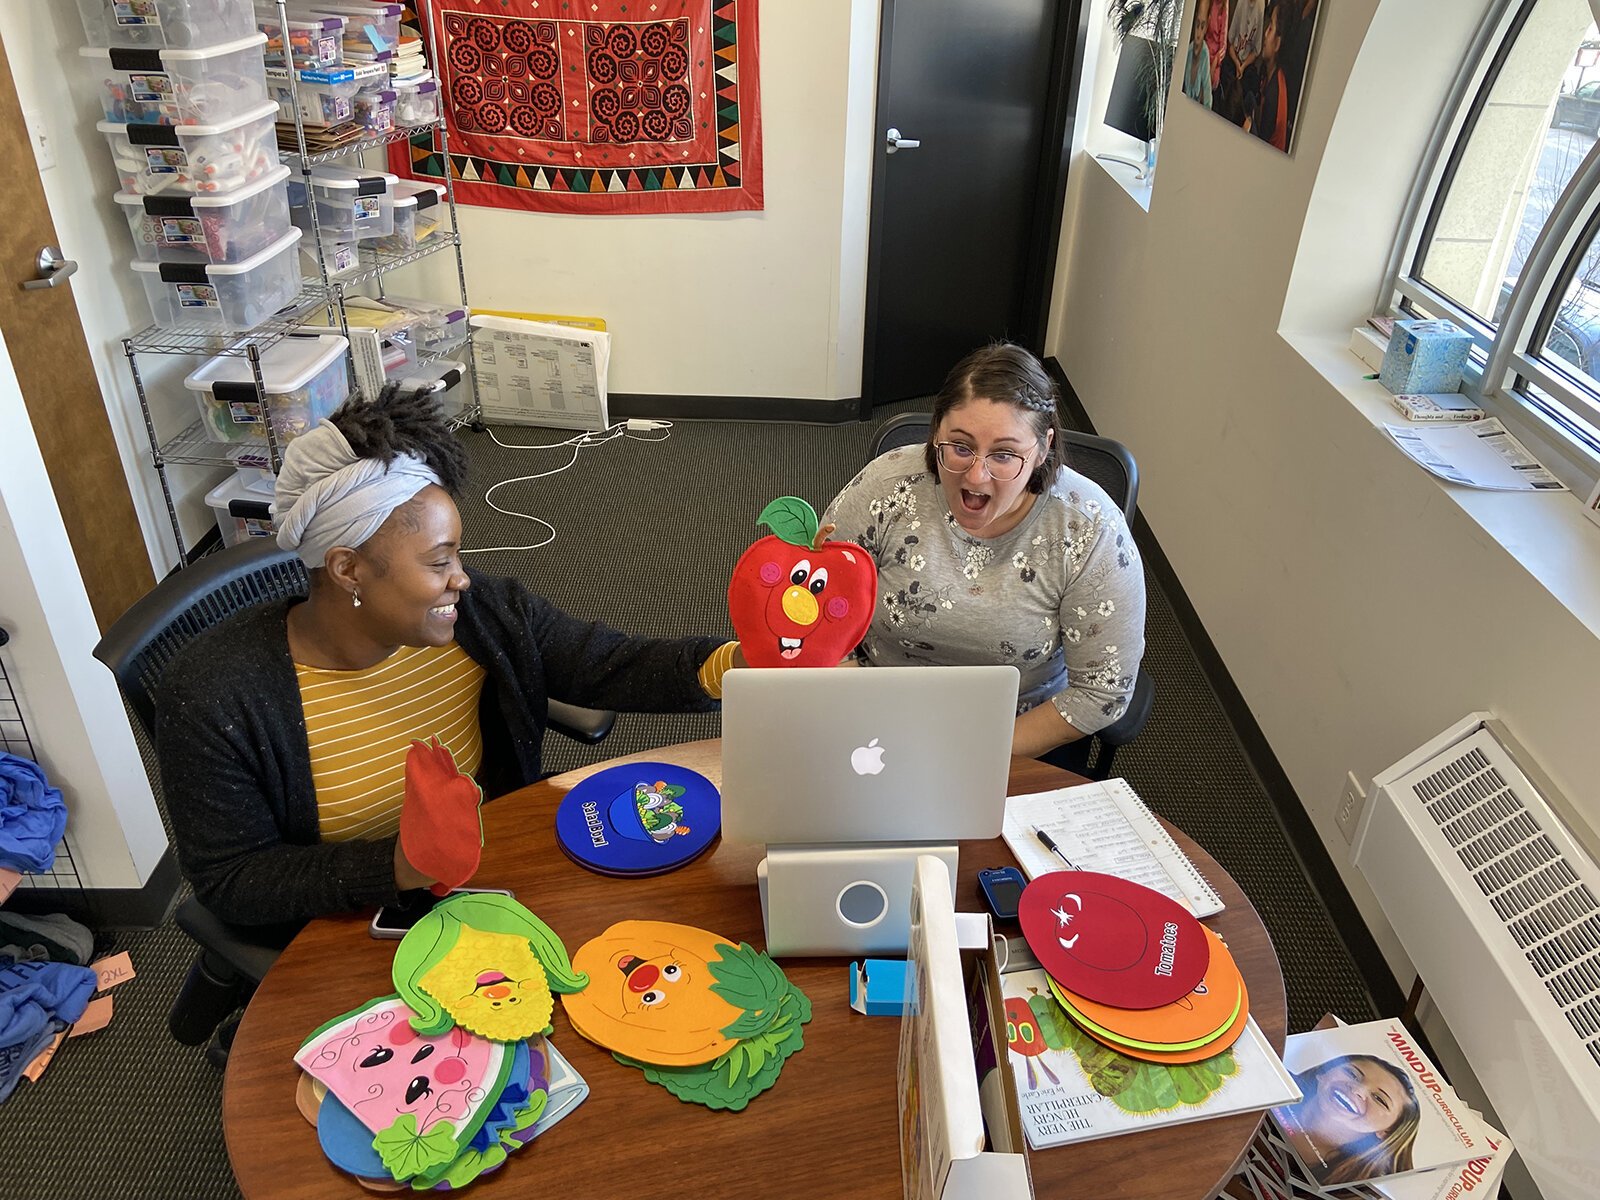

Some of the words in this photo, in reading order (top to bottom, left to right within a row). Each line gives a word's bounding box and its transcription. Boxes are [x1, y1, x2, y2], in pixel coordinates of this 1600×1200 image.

[582, 801, 602, 827] Salad
[589, 826, 608, 847] Bowl
[1154, 921, 1178, 977] Tomatoes
[100, 967, 128, 984] 2XL
[1021, 1091, 1040, 1100] Carle
[1041, 1088, 1055, 1097] Eric
[1026, 1093, 1102, 1115] CATERPILLAR
[1032, 1108, 1080, 1125] HUNGRY
[1067, 1118, 1092, 1131] THE
[1433, 1095, 1474, 1147] CURRICULUM
[1037, 1123, 1067, 1137] VERY
